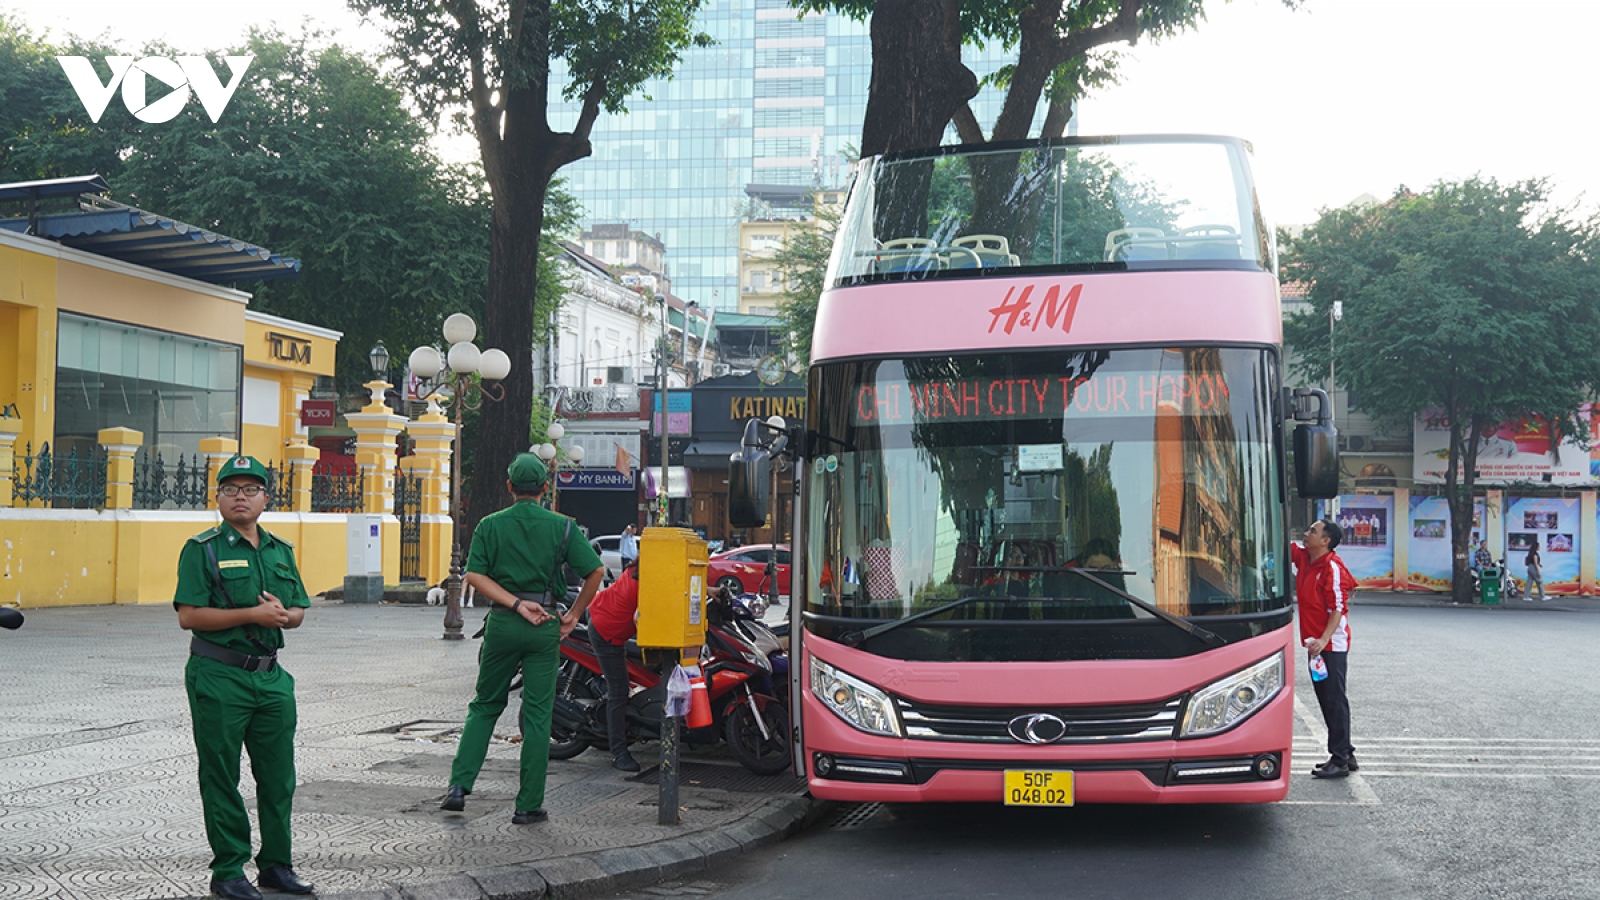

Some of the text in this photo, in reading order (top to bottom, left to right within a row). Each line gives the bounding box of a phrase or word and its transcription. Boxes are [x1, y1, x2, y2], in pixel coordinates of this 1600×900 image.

[988, 283, 1084, 335] H&M
[268, 331, 312, 365] TUMI
[857, 384, 902, 420] CHI
[910, 380, 980, 418] MINH
[988, 377, 1049, 416] CITY
[1058, 375, 1130, 413] TOUR
[305, 408, 331, 418] TUMI
[578, 474, 594, 484] MY
[595, 474, 620, 485] BANH
[1023, 773, 1053, 787] 50F
[1011, 789, 1066, 804] 048.02
